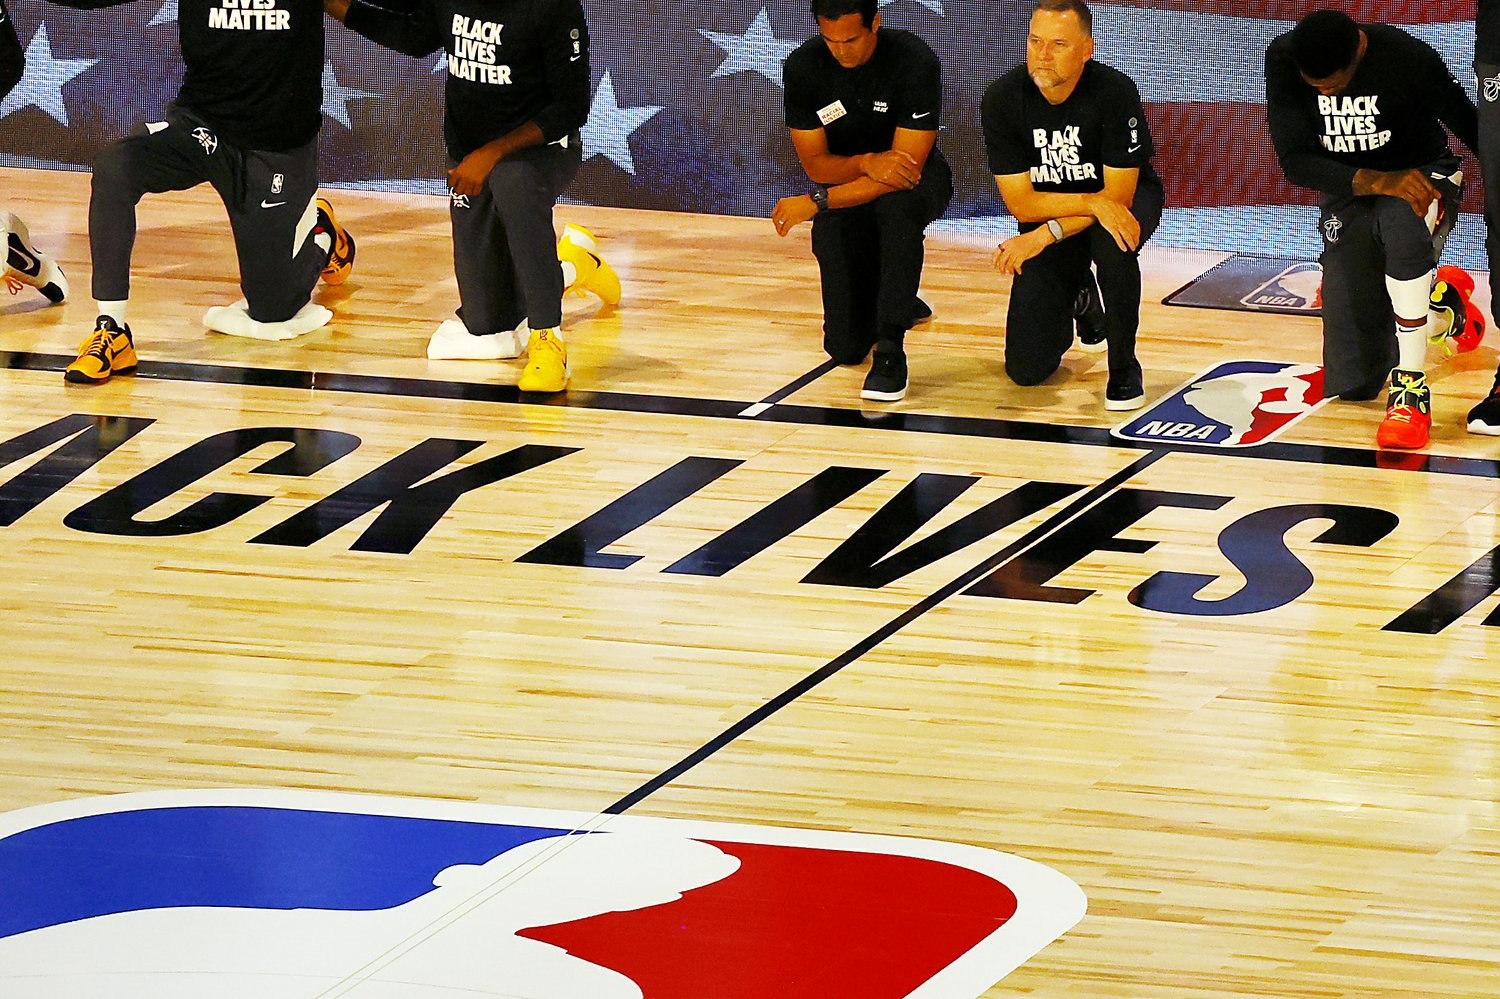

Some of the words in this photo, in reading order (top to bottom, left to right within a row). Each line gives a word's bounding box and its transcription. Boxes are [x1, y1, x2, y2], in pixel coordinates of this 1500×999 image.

[208, 7, 291, 30] MATTER
[451, 13, 504, 45] BLACK
[454, 36, 496, 64] LIVES
[448, 53, 513, 85] MATTER
[1317, 95, 1380, 116] BLACK
[1324, 115, 1377, 135] LIVES
[1319, 129, 1392, 152] MATTER
[1030, 162, 1098, 184] MATTER
[1254, 295, 1298, 306] NBA
[1135, 420, 1217, 440] NBA
[514, 456, 1400, 616] LIVES
